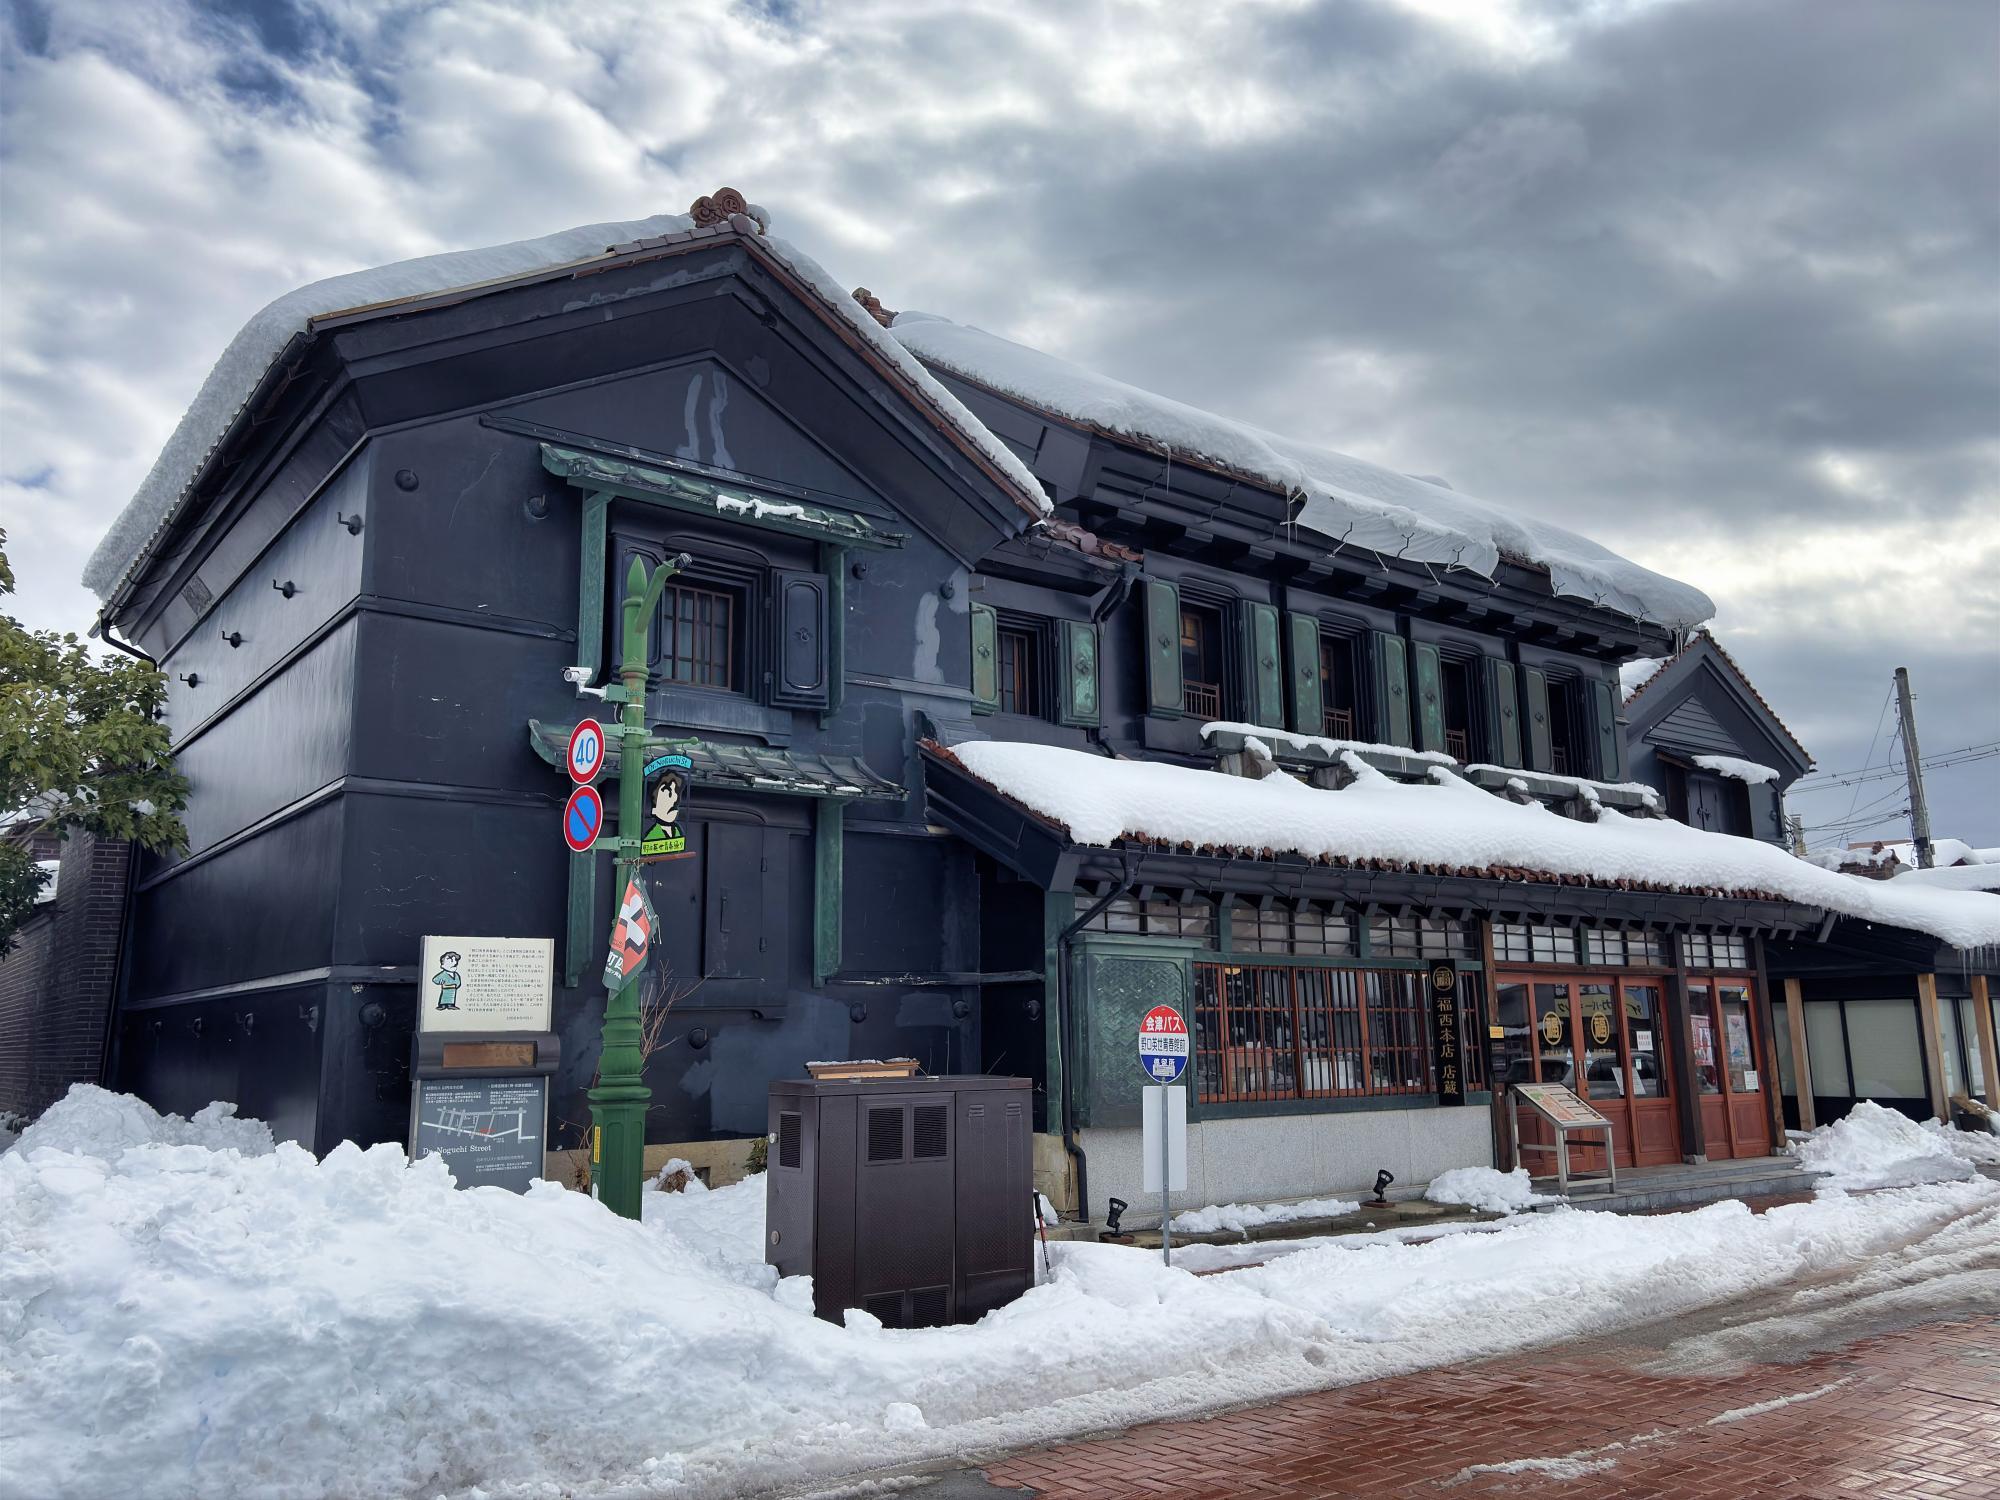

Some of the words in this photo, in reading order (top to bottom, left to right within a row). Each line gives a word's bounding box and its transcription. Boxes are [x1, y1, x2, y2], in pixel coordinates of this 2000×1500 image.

[576, 736, 596, 766] 40
[1146, 1015, 1181, 1032] 会津バス
[1437, 997, 1455, 1059] 福西本店
[436, 1145, 468, 1155] Noguchi
[470, 1144, 492, 1152] Street
